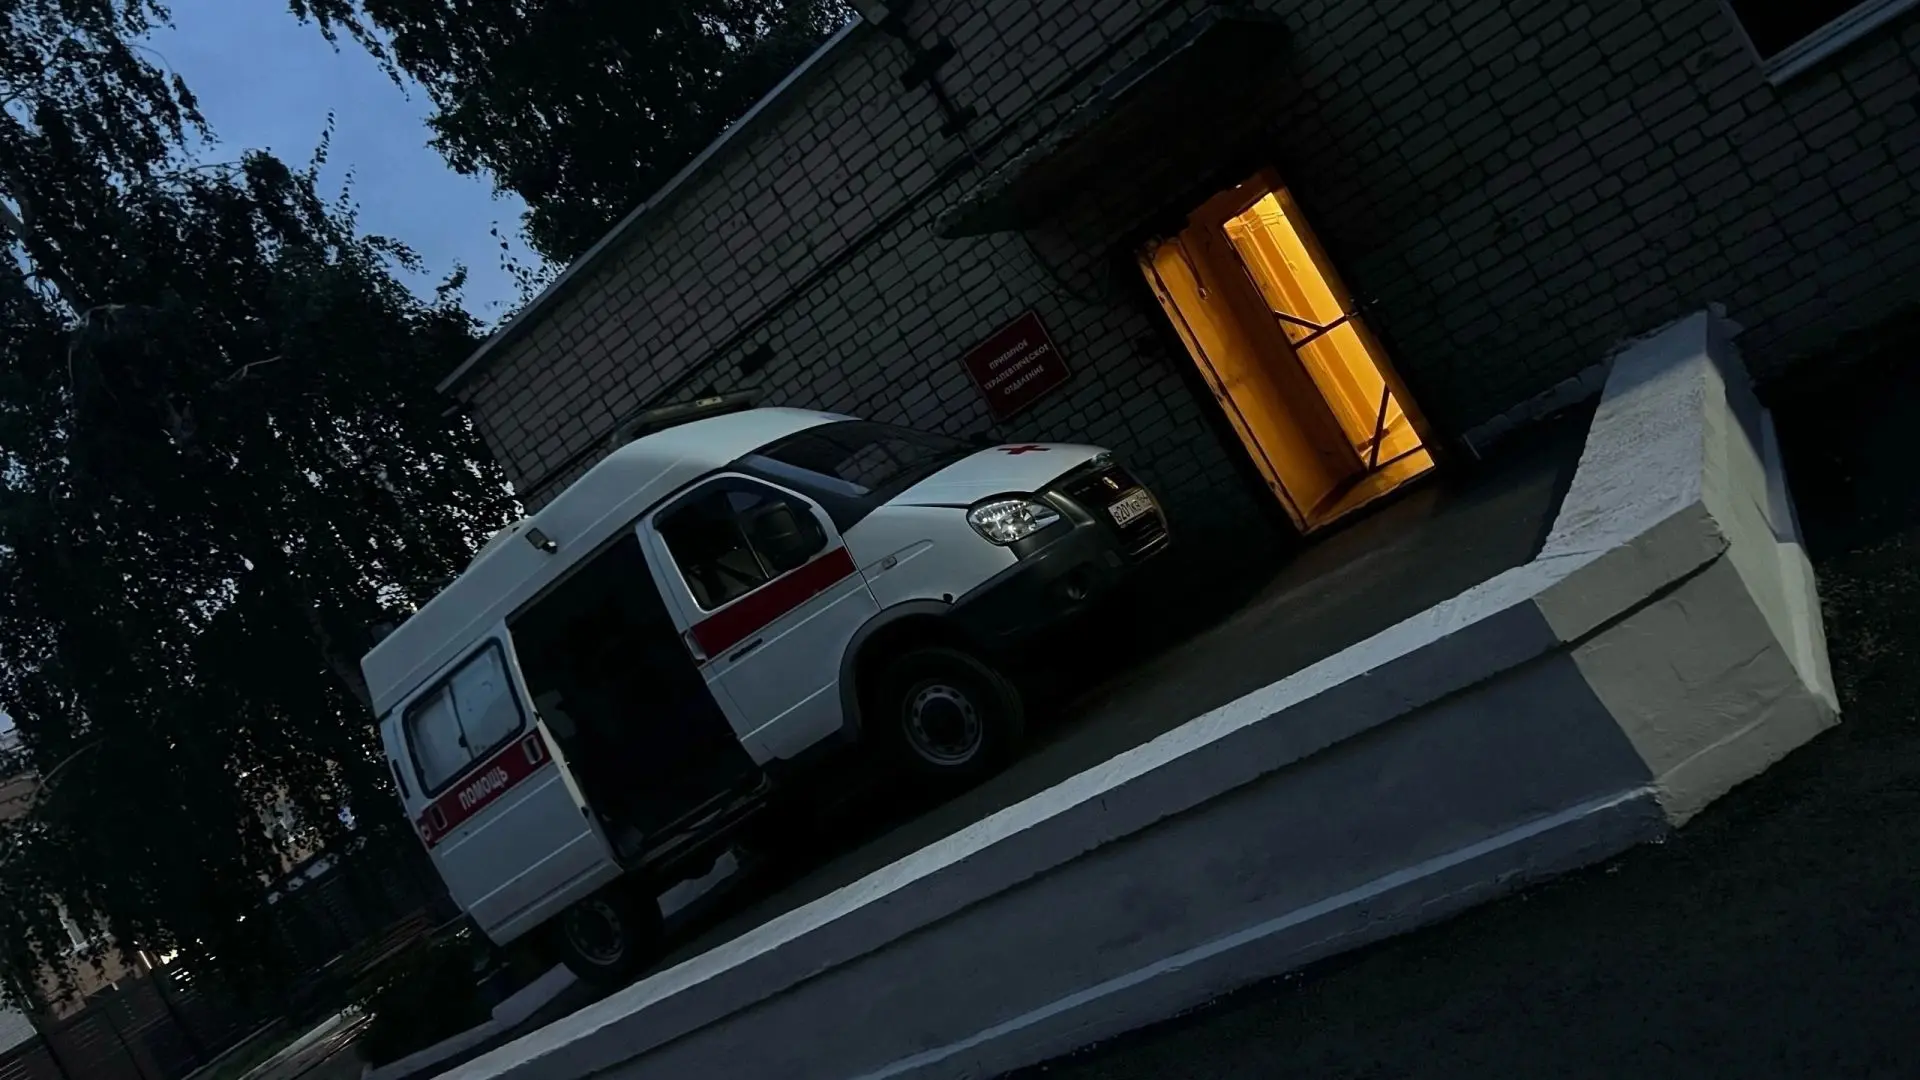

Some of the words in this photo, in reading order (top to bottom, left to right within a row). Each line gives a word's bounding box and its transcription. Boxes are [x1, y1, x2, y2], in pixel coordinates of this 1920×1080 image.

[983, 344, 1049, 391] ТЕРАПЕВТИЧЕСКОЕ
[1004, 364, 1045, 395] ОТДЕЛЕНИЕ
[458, 766, 509, 811] ПОМОЩЬ
